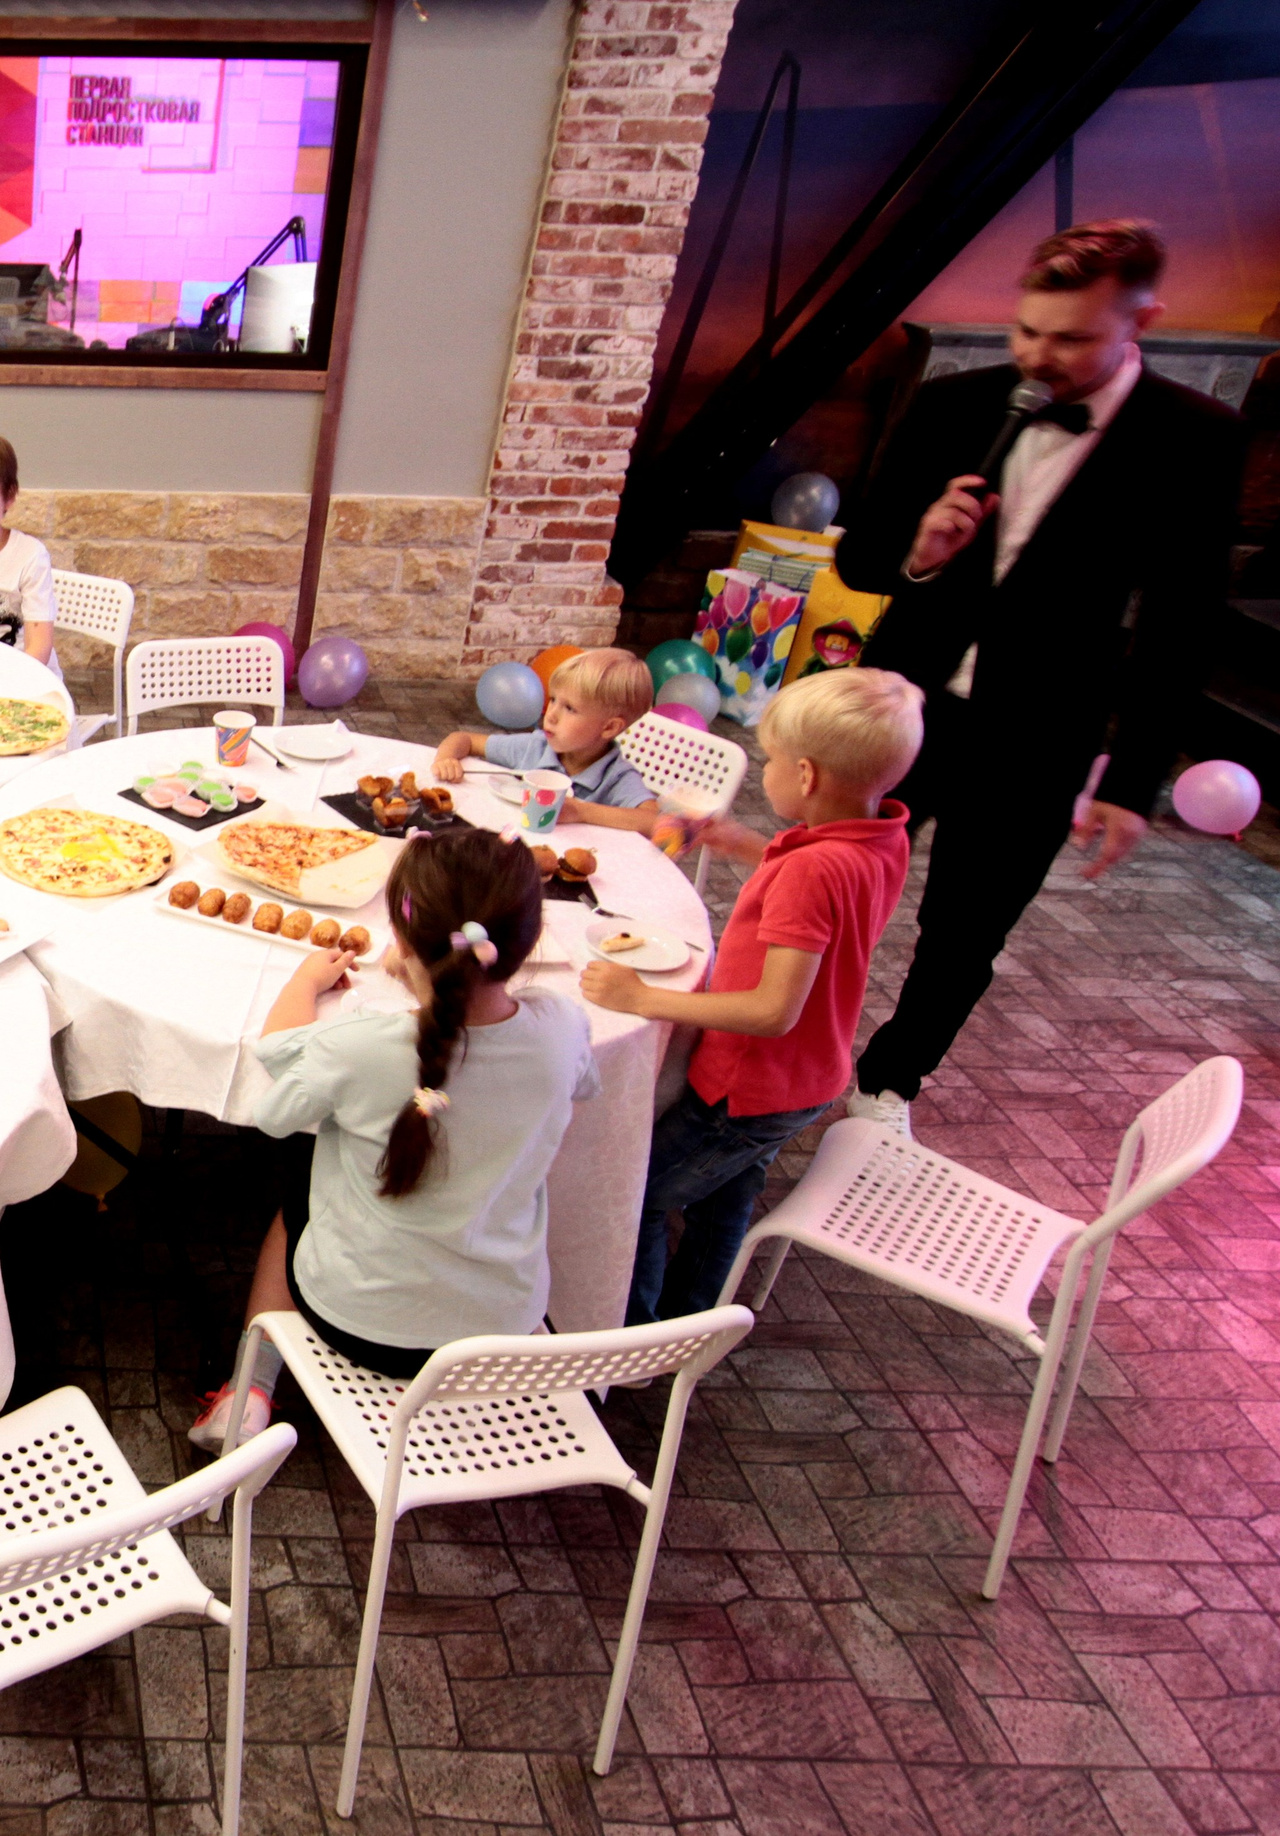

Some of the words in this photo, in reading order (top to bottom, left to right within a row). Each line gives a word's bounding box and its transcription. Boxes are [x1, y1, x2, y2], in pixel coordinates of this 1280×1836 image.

[69, 74, 131, 99] ПЕРВАЯ
[67, 97, 200, 123] ПОДРОСТКОВАЯ
[66, 122, 144, 148] СТАНЦИЯ
